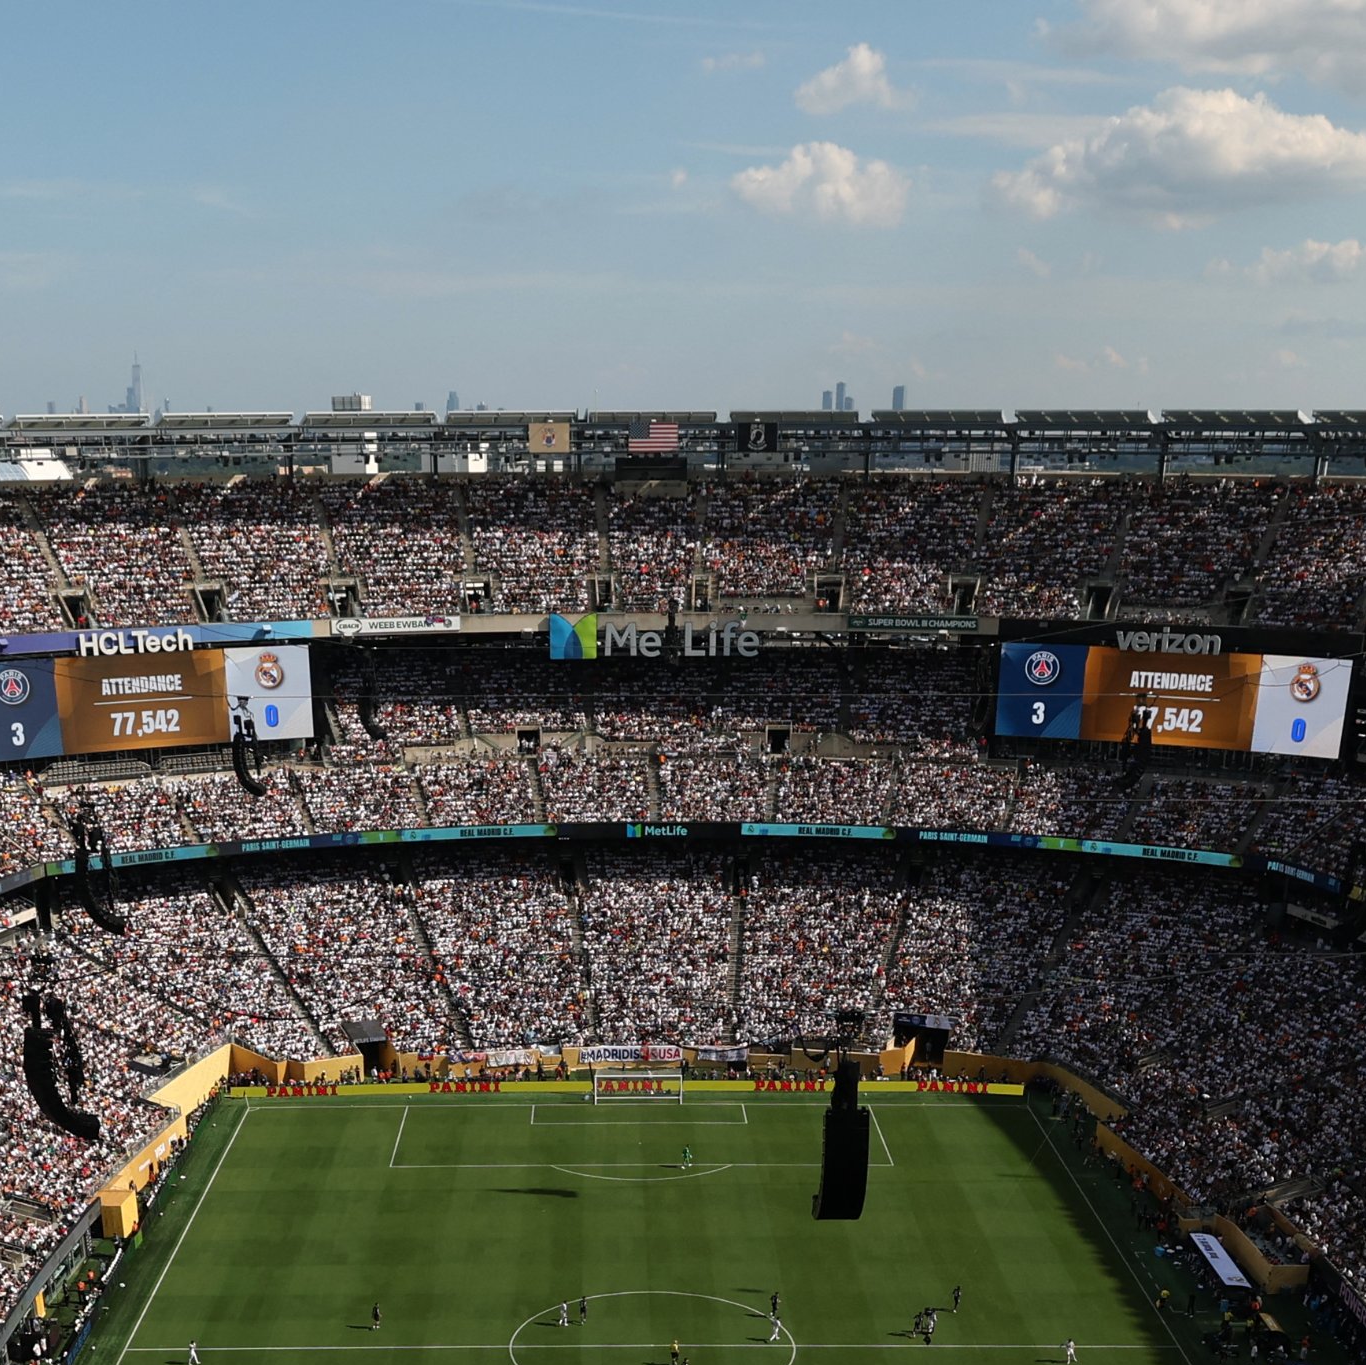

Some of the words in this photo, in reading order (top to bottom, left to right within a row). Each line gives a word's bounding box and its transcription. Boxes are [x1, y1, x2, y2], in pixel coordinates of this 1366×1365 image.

[368, 621, 395, 631] WEEB
[868, 618, 893, 627] SUPER
[895, 619, 920, 628] BOWL
[928, 620, 977, 629] CHAMPIONS
[79, 628, 194, 658] HCLTech
[604, 621, 759, 657] MeLife
[1116, 630, 1222, 655] verizon
[101, 673, 183, 696] ATTENDANCE
[1129, 671, 1214, 693] ATTENDANCE
[264, 704, 279, 728] 0
[1032, 702, 1045, 724] 3
[1135, 706, 1203, 733] 7,542
[110, 708, 180, 737] 77,542
[11, 722, 25, 746] 3
[1291, 718, 1306, 742] 0
[460, 828, 476, 838] REAL
[477, 828, 502, 838] MADRID
[645, 825, 688, 837] MetLife
[798, 826, 814, 836] REAL
[815, 826, 840, 837] MADRID
[919, 831, 938, 842] PARIS
[939, 832, 988, 844] SAINT-GERMAIN
[241, 842, 260, 852] PARIS
[261, 839, 310, 852] SAINT-GERMAIN
[121, 854, 136, 865] REAL
[137, 852, 163, 863] MADRID
[1141, 847, 1158, 858] REAL
[1159, 848, 1186, 861] MADRID
[266, 1086, 338, 1097] PANINI
[429, 1082, 501, 1093] PANINI
[753, 1080, 826, 1092] PANINI
[916, 1081, 988, 1094] PANINI
